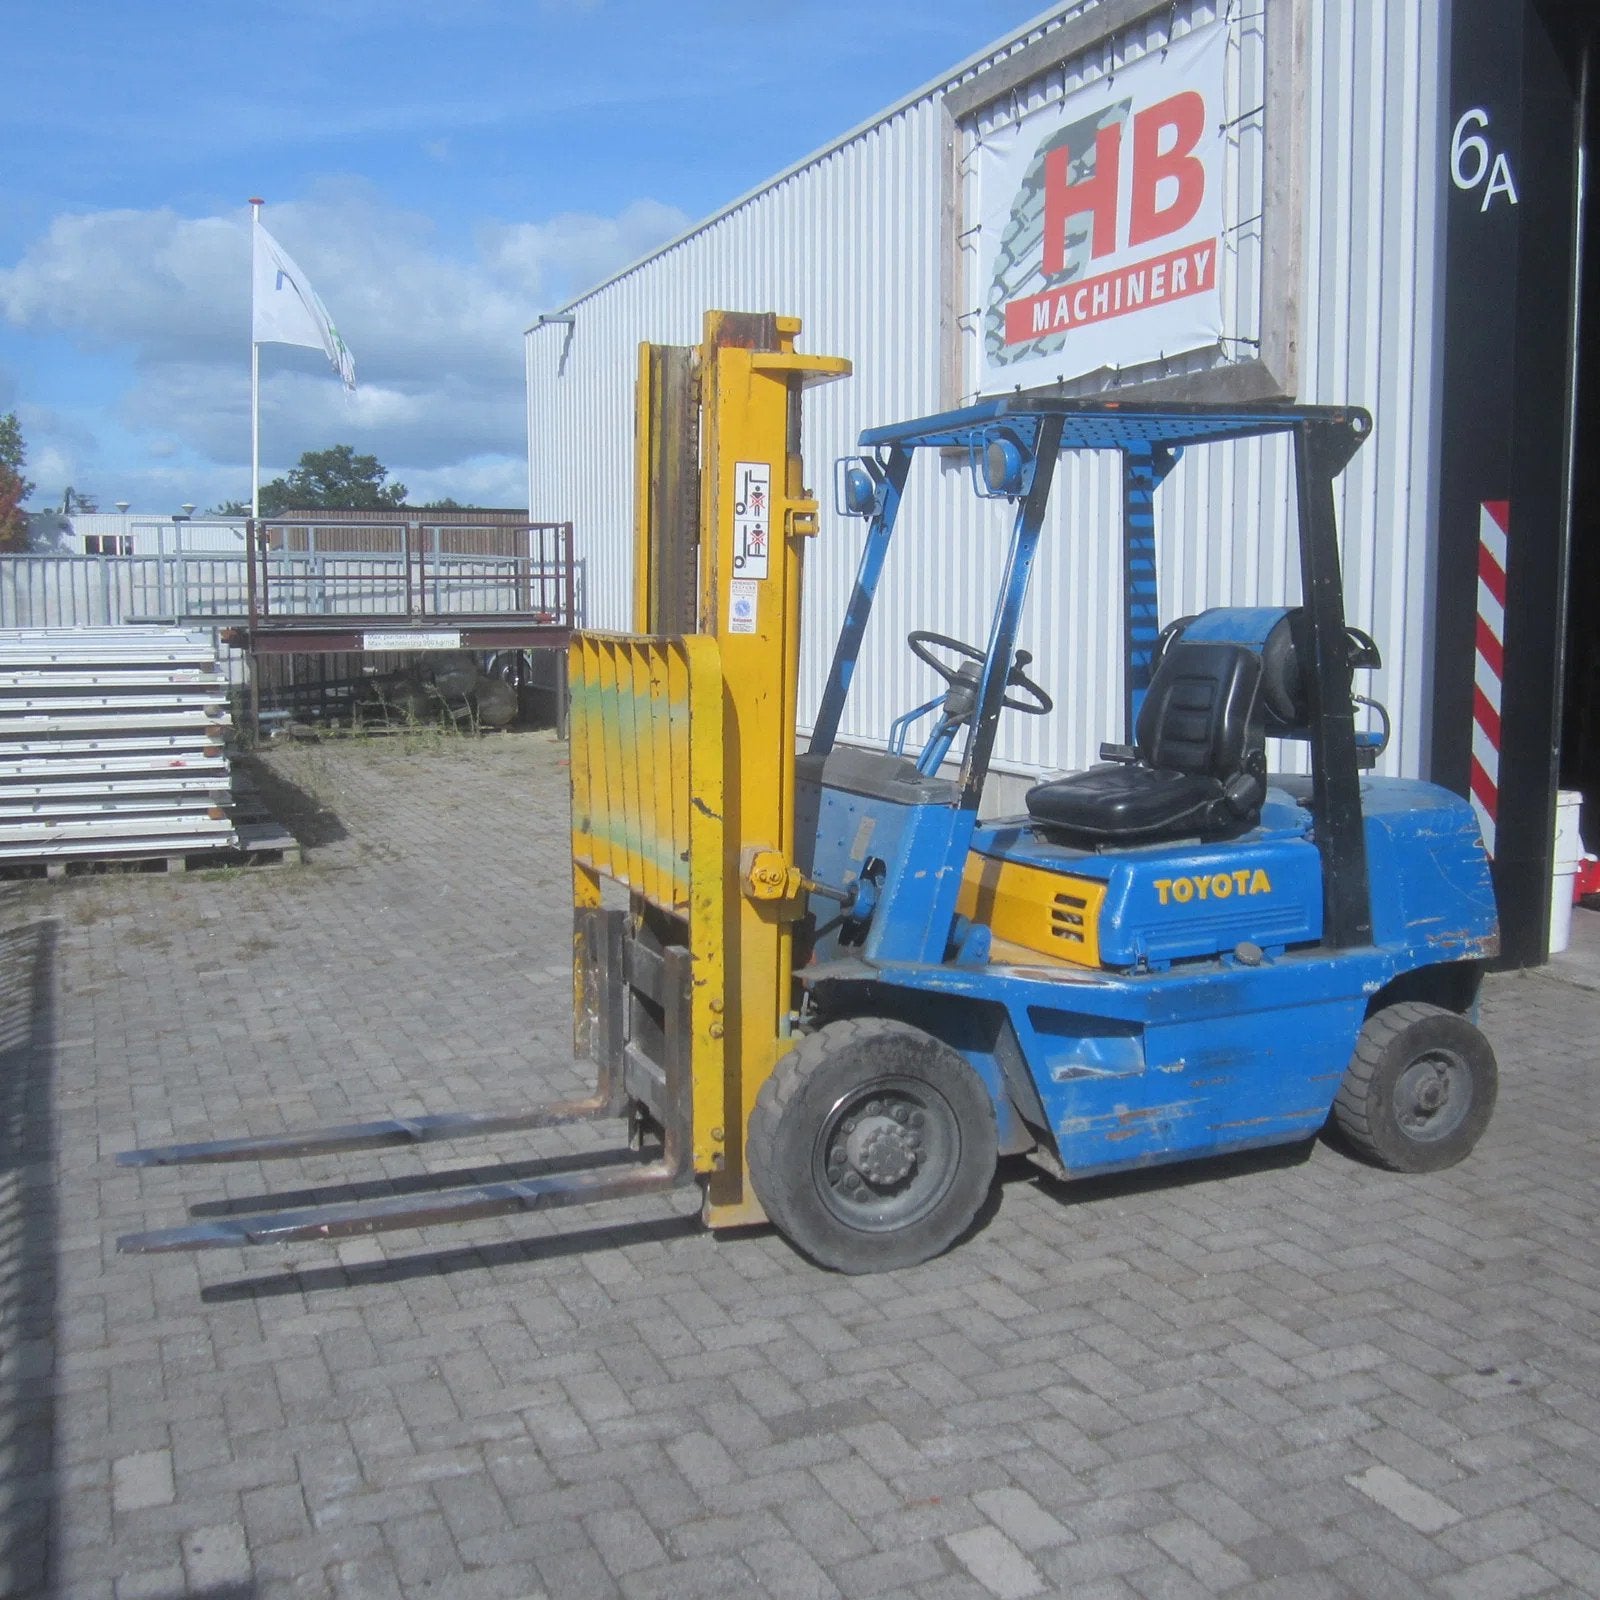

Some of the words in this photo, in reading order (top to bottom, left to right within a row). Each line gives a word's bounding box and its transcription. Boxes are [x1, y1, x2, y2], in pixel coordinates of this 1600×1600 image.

[1042, 91, 1205, 275] HB
[1451, 109, 1518, 212] 6A
[1032, 249, 1211, 332] MACHINERY
[1153, 869, 1271, 905] TOYOTA
